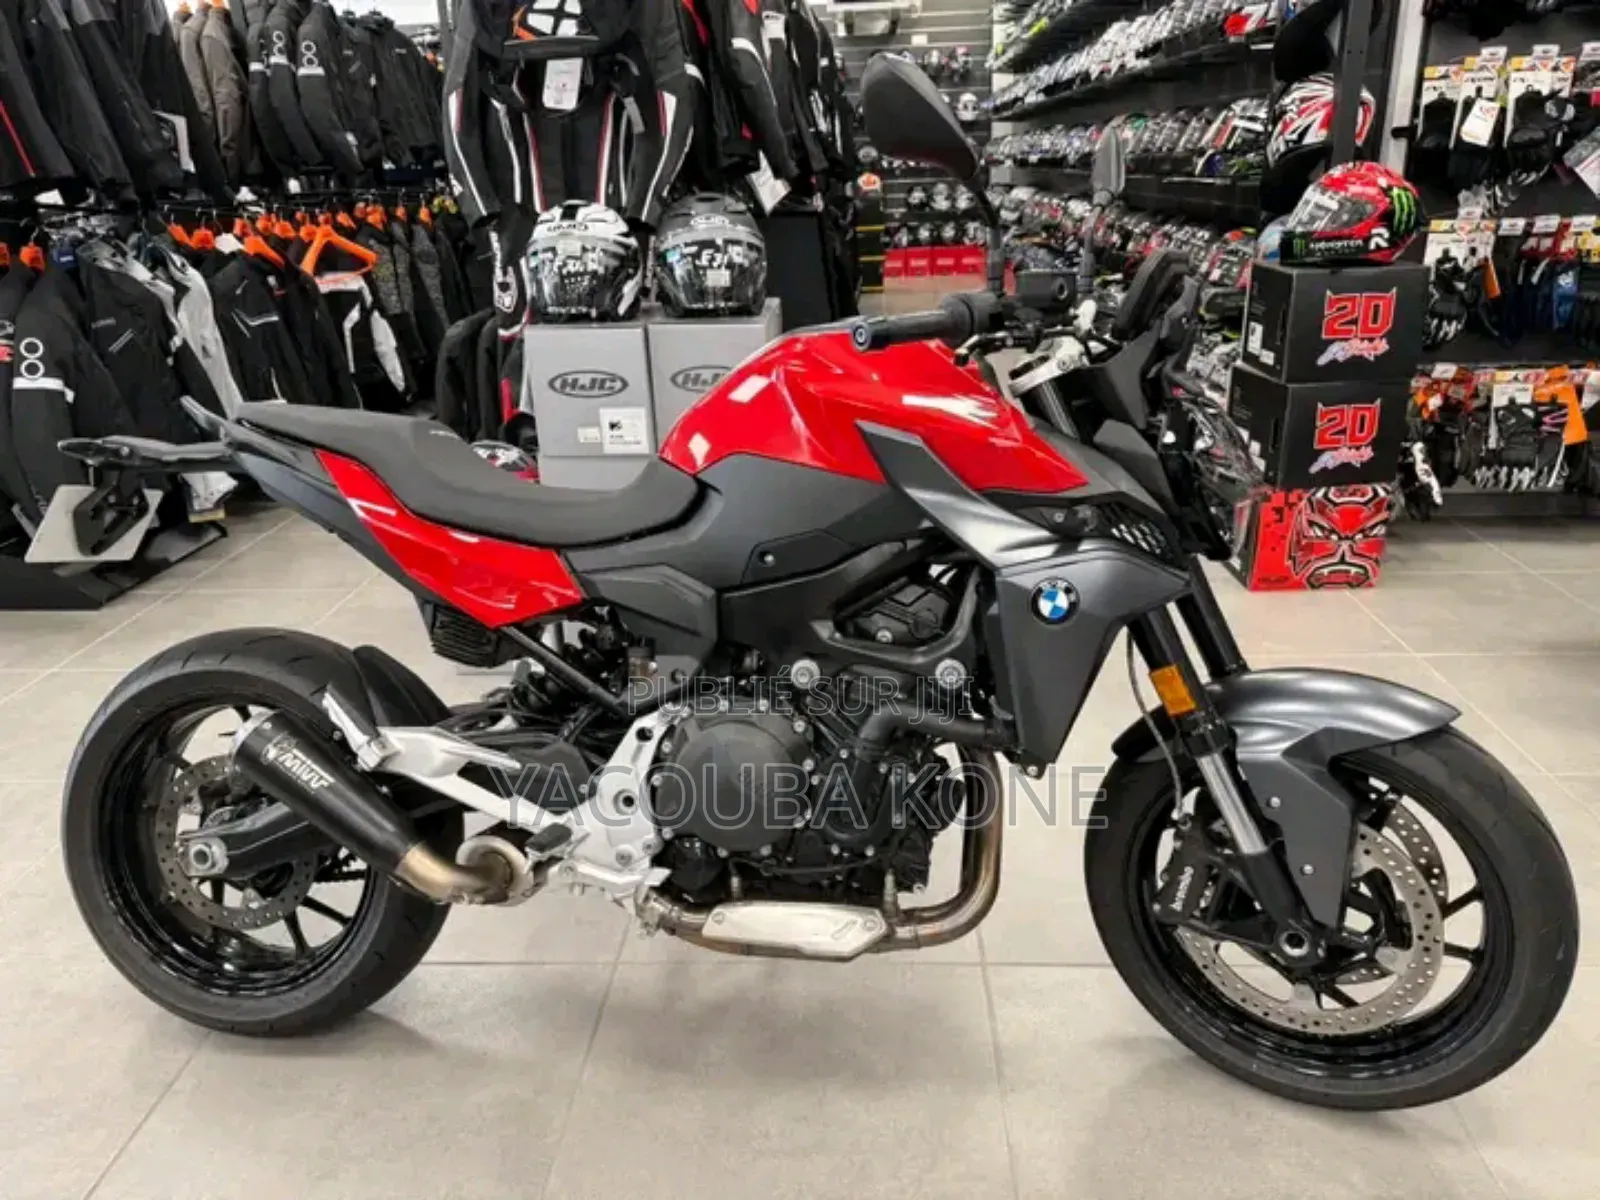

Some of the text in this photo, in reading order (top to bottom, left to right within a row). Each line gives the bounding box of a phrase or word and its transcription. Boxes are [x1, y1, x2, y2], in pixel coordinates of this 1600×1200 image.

[1322, 287, 1396, 339] 20
[560, 377, 617, 392] HJC
[682, 373, 724, 387] HJ
[1313, 398, 1381, 449] 20
